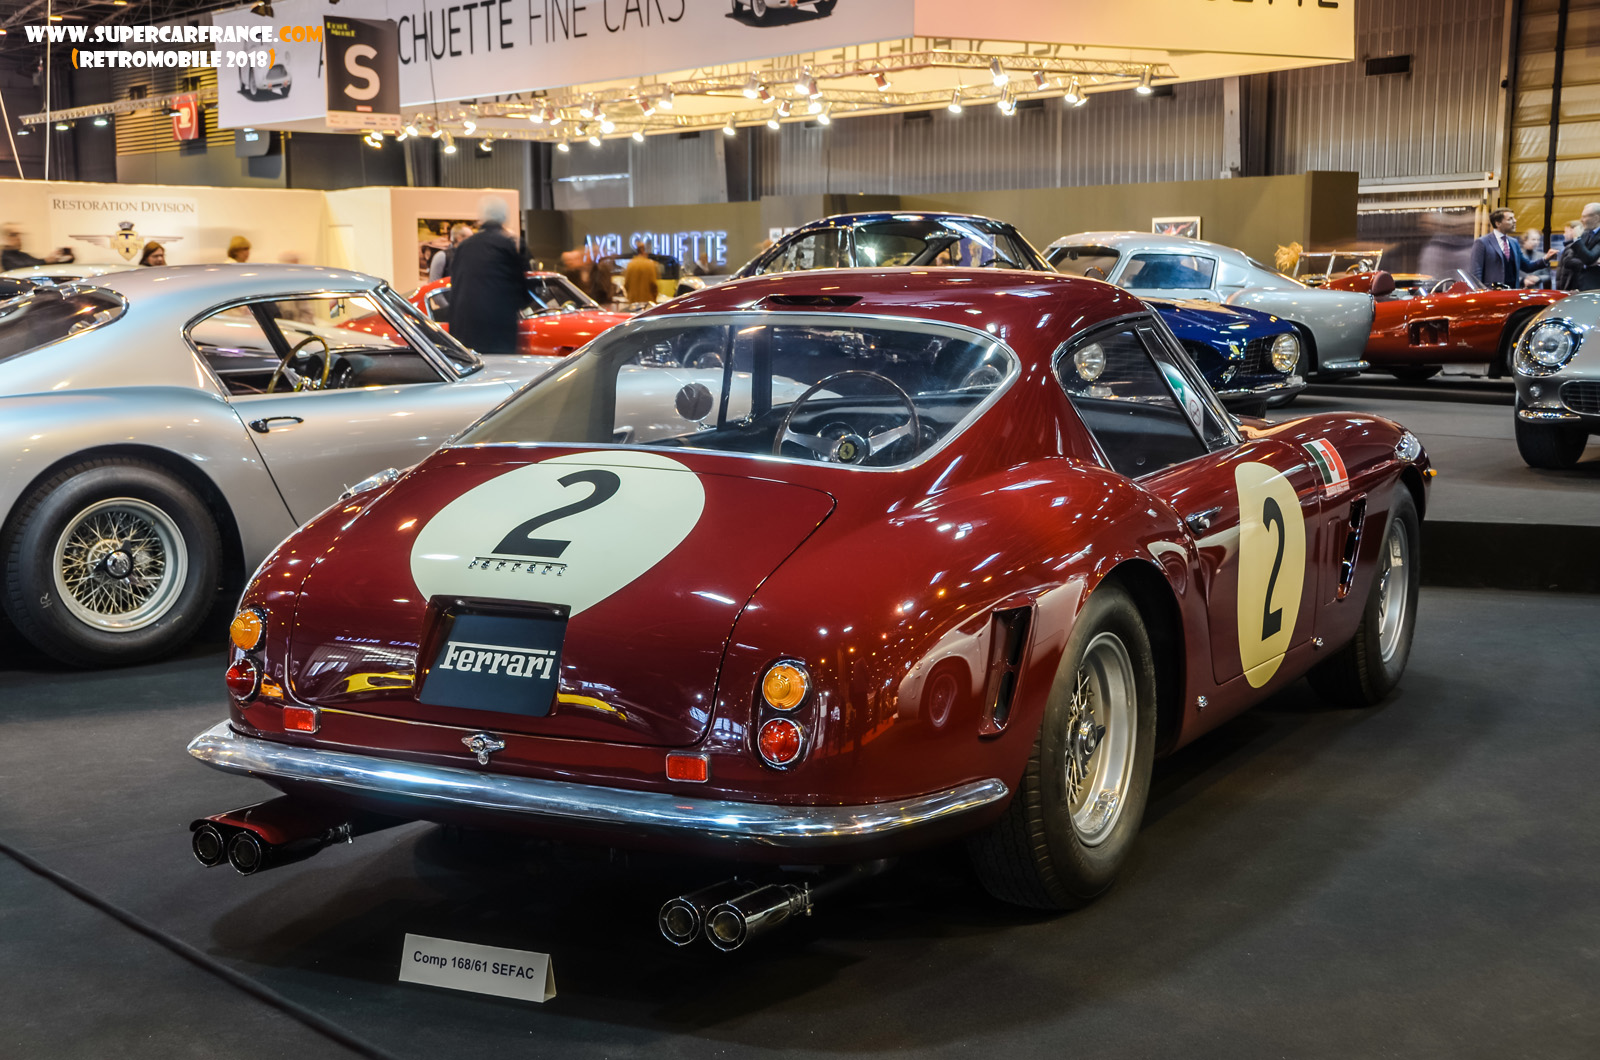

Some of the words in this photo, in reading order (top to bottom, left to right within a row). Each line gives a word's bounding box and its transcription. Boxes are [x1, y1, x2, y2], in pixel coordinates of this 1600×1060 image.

[387, 0, 514, 65] CHUETTE
[528, 0, 587, 45] FINE
[343, 44, 381, 101] S
[52, 199, 137, 212] RESTORATION
[141, 201, 195, 213] DIVISION
[490, 469, 621, 558] 2
[467, 556, 569, 577] Ferrari
[1261, 496, 1286, 642] 2
[438, 640, 557, 680] Ferrari
[413, 950, 448, 969] Comp
[451, 956, 488, 973] 168/61
[491, 962, 535, 980] SEFAC
